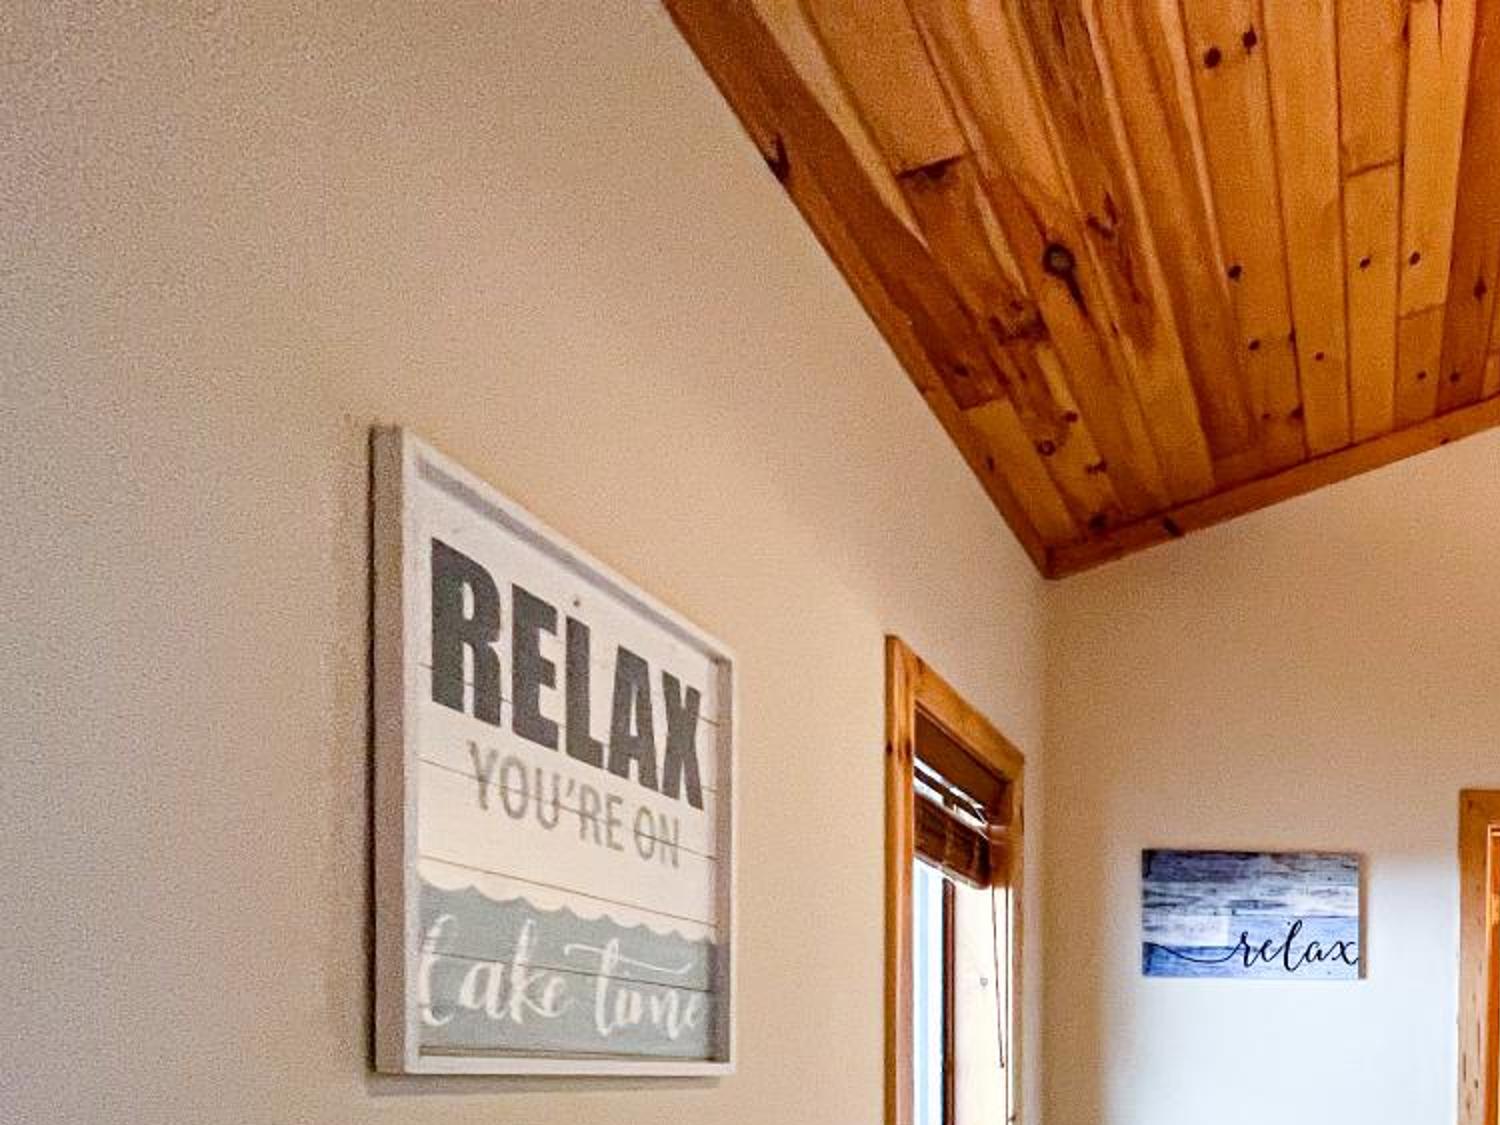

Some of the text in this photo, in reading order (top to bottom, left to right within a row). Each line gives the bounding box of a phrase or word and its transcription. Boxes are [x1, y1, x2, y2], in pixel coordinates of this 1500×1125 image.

[431, 536, 705, 812] RELAX
[466, 738, 681, 870] YOU'RE ON
[1225, 918, 1359, 972] relax
